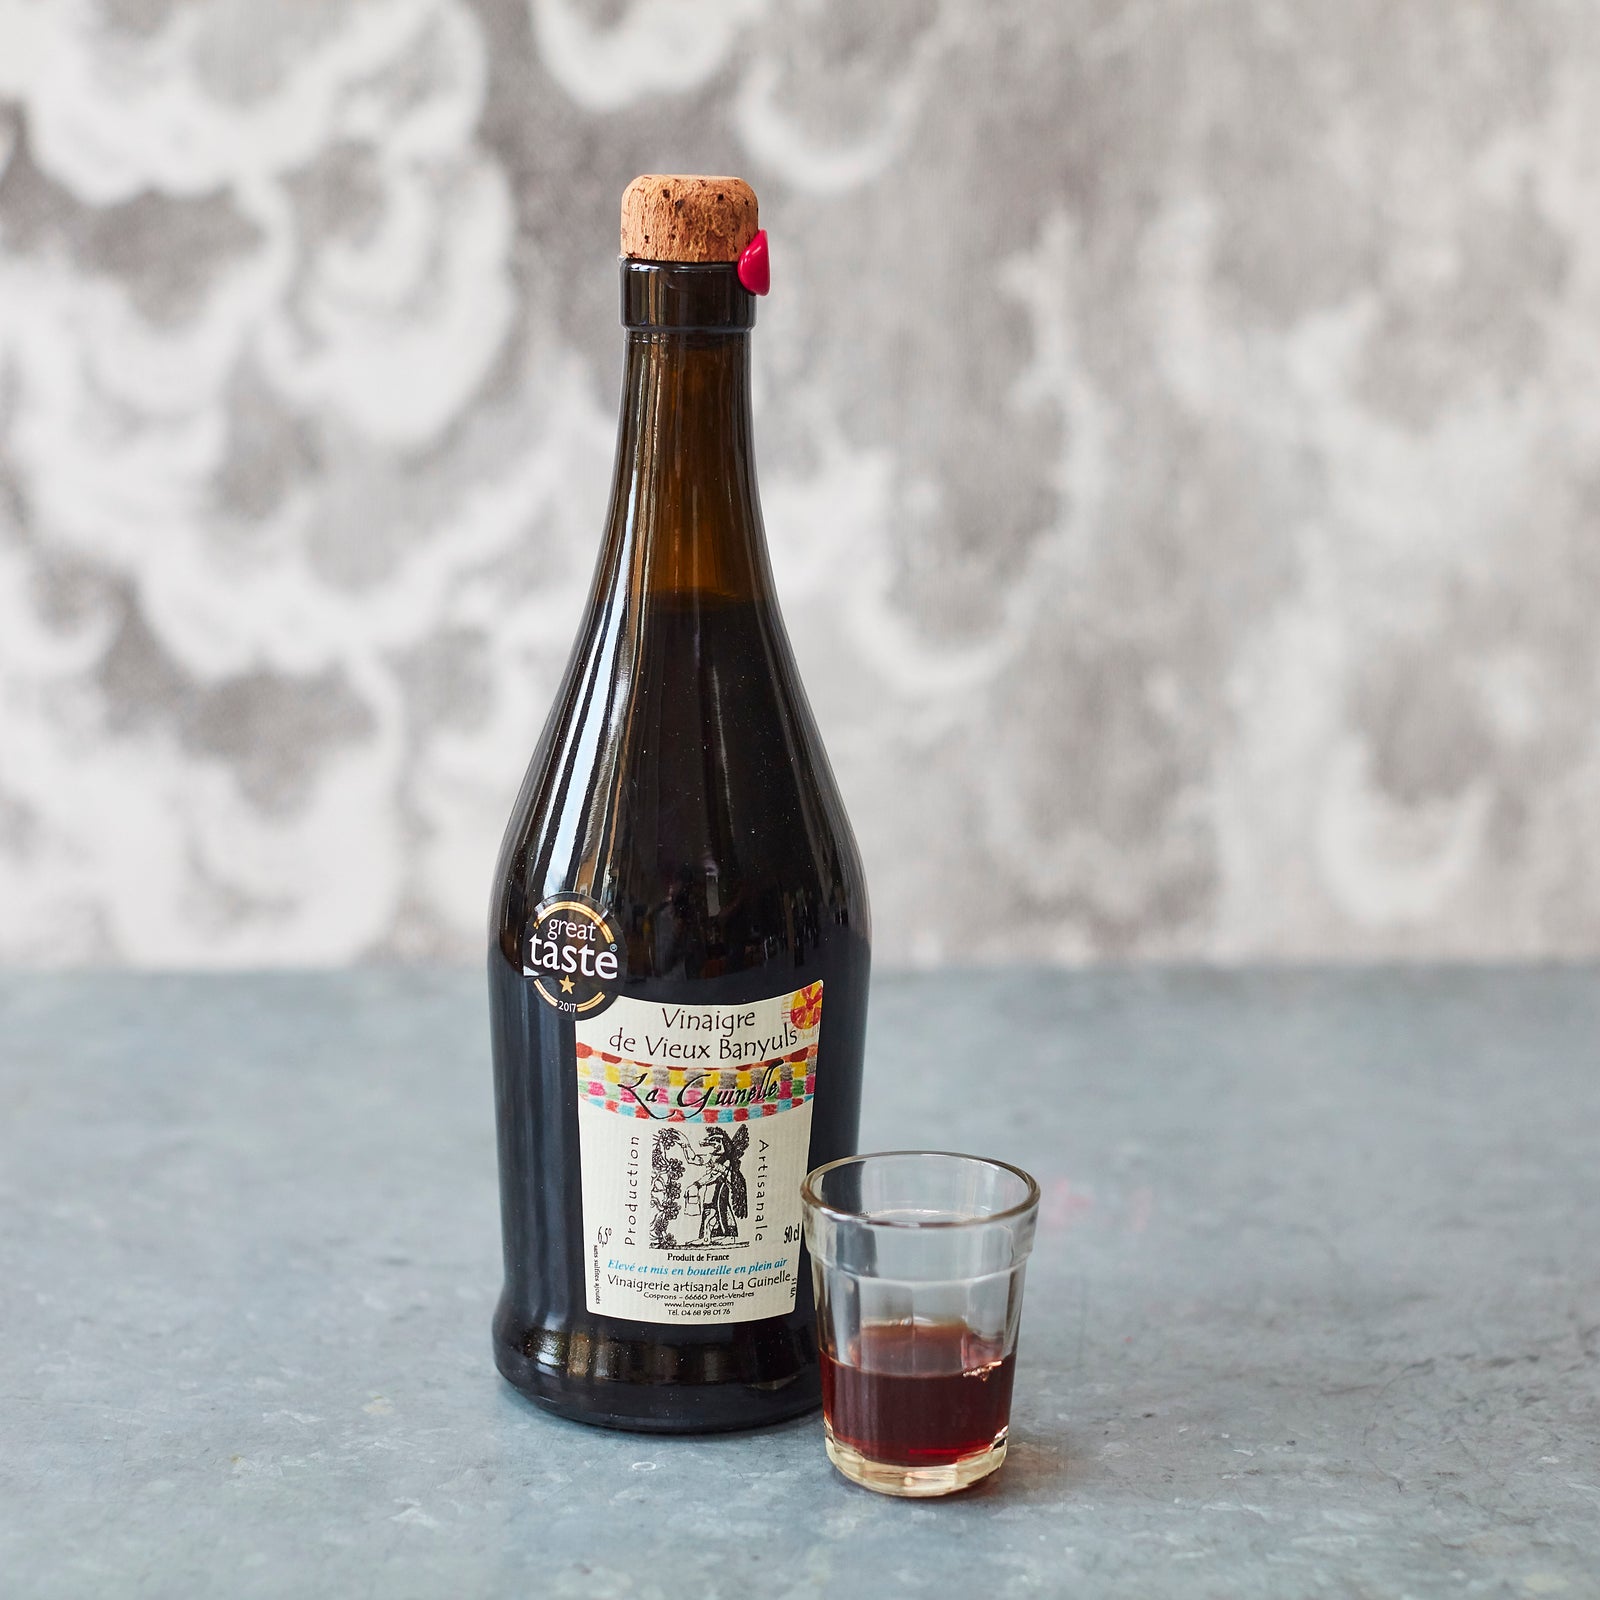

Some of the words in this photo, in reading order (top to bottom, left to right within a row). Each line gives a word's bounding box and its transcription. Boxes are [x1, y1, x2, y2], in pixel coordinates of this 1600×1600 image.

[547, 918, 597, 941] great
[528, 933, 618, 979] taste
[558, 1000, 577, 1013] 2017
[661, 1007, 755, 1038] Vinaigre
[609, 1027, 636, 1053] de
[644, 1035, 711, 1059] Vieux
[719, 1022, 798, 1060] Banyuls
[617, 1073, 676, 1120] La
[677, 1059, 785, 1120] Guinelle
[624, 1136, 640, 1246] Production
[754, 1139, 770, 1241] Artisanale
[783, 1225, 793, 1244] 50
[607, 1259, 636, 1272] Elevé
[638, 1265, 648, 1273] et
[650, 1265, 669, 1275] mis
[671, 1268, 684, 1276] en
[686, 1265, 732, 1276] bouteille
[734, 1266, 746, 1274] en
[748, 1260, 772, 1275] plein
[774, 1258, 787, 1267] air
[667, 1253, 695, 1262] Produit
[696, 1253, 704, 1261] de
[706, 1253, 730, 1261] France
[607, 1274, 670, 1292] Vinaigrerie
[673, 1278, 729, 1292] artisanale
[732, 1279, 744, 1290] La
[747, 1269, 791, 1289] Guinelle
[643, 1291, 677, 1301] Cosprons
[709, 1291, 755, 1300] Port-Vendres
[664, 1301, 735, 1309] www.levinaigre.com
